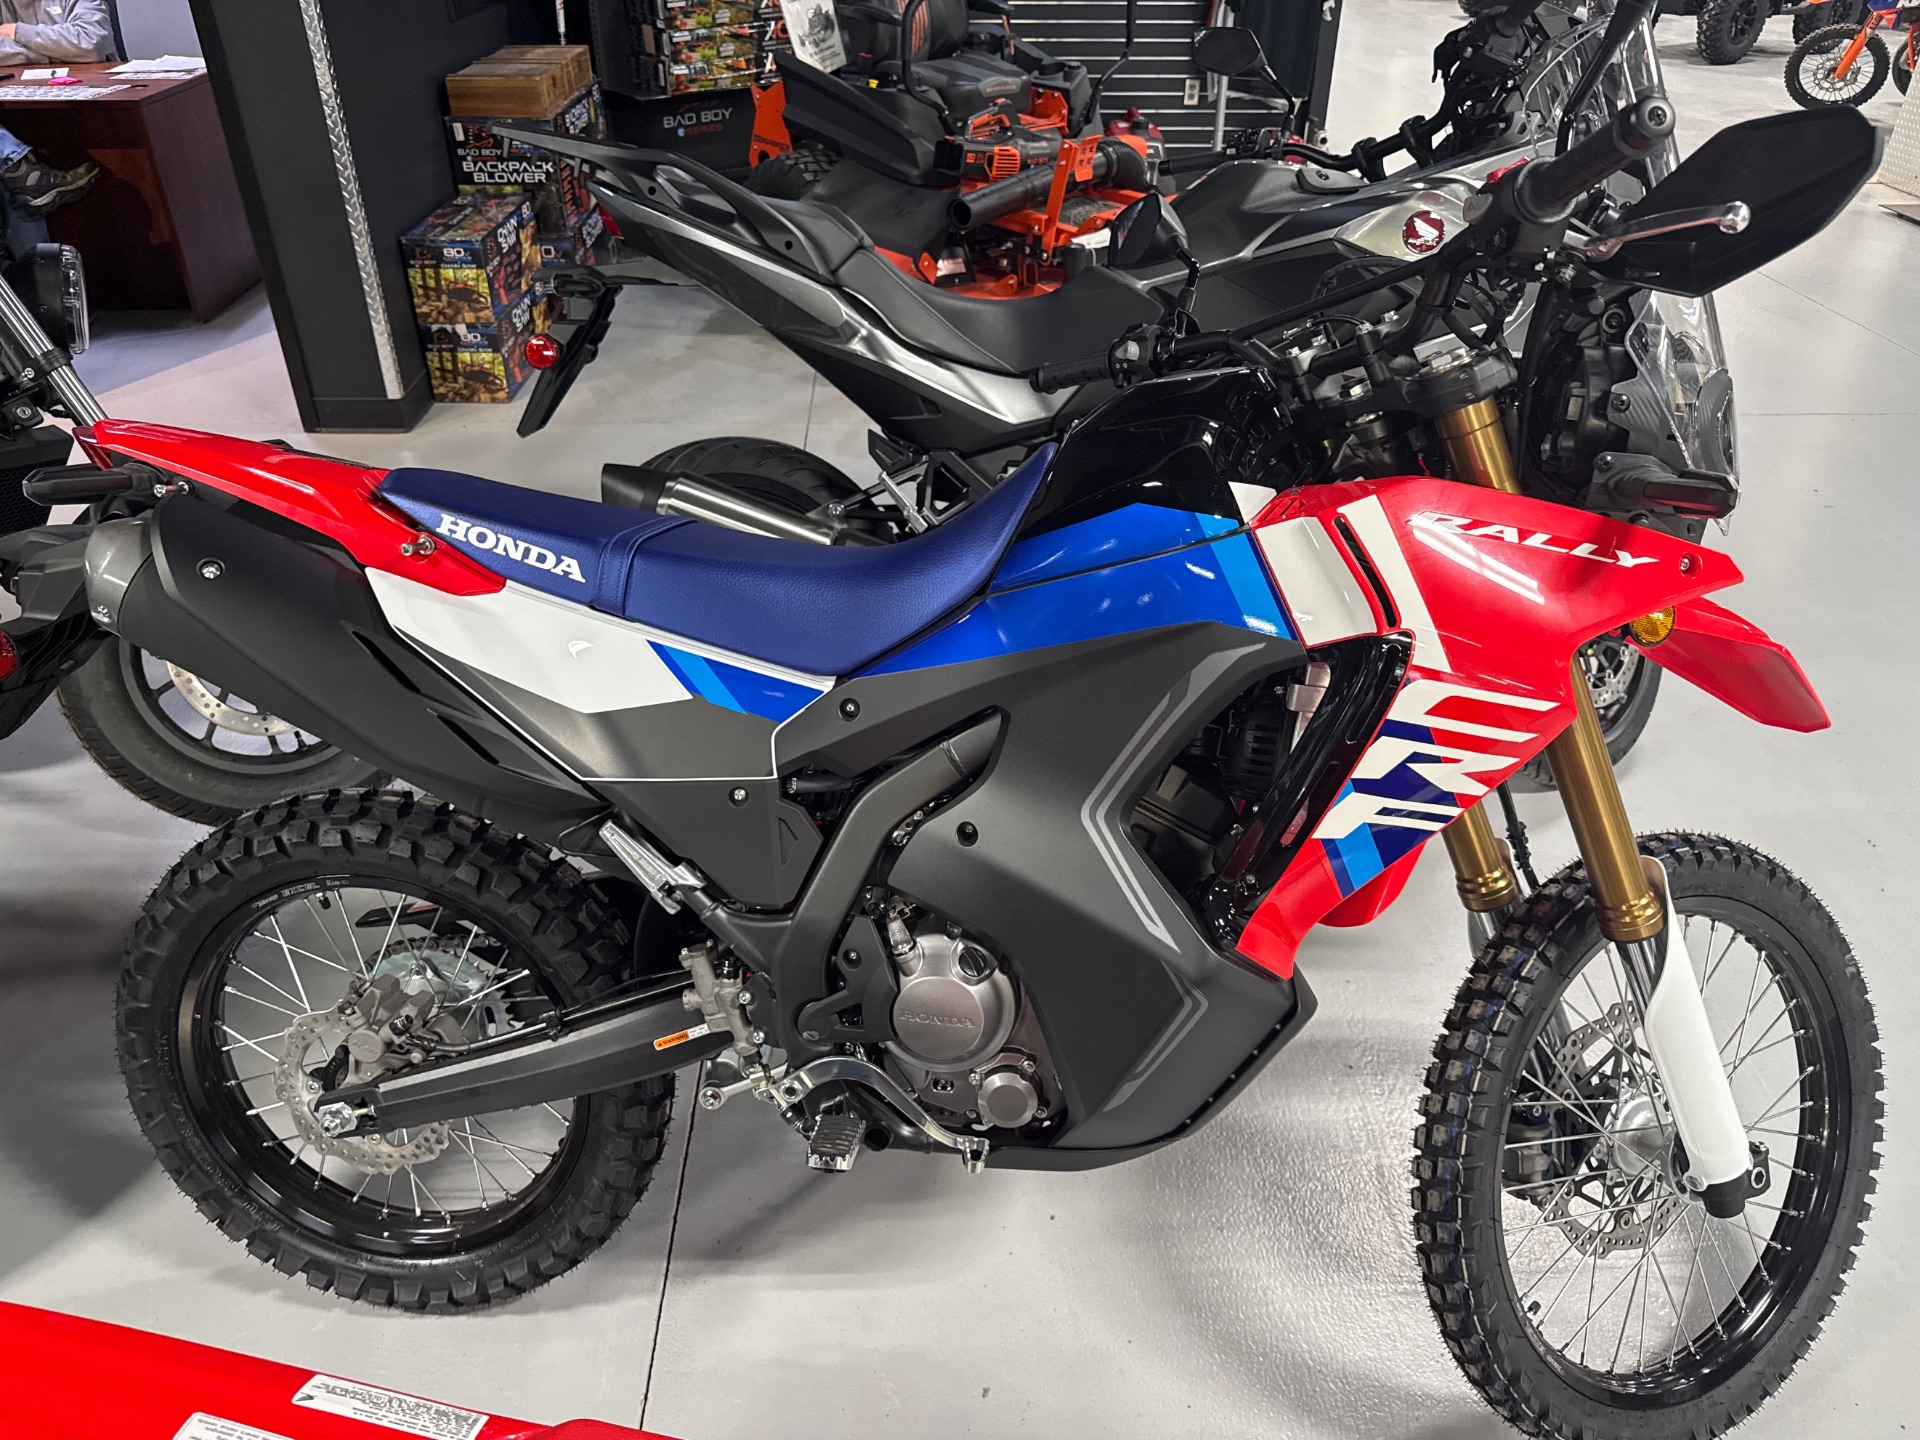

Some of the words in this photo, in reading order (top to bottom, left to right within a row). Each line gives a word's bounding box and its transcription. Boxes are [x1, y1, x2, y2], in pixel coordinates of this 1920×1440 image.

[663, 113, 697, 129] BAD
[701, 107, 733, 123] BOY
[457, 148, 479, 156] BAD
[481, 148, 503, 156] BOY
[462, 161, 555, 173] BACKPACK
[473, 172, 547, 183] BLOWER
[1406, 510, 1660, 568] RALLY
[435, 513, 586, 583] HONDA
[899, 1010, 977, 1029] HONDA
[662, 1033, 690, 1046] WARNING
